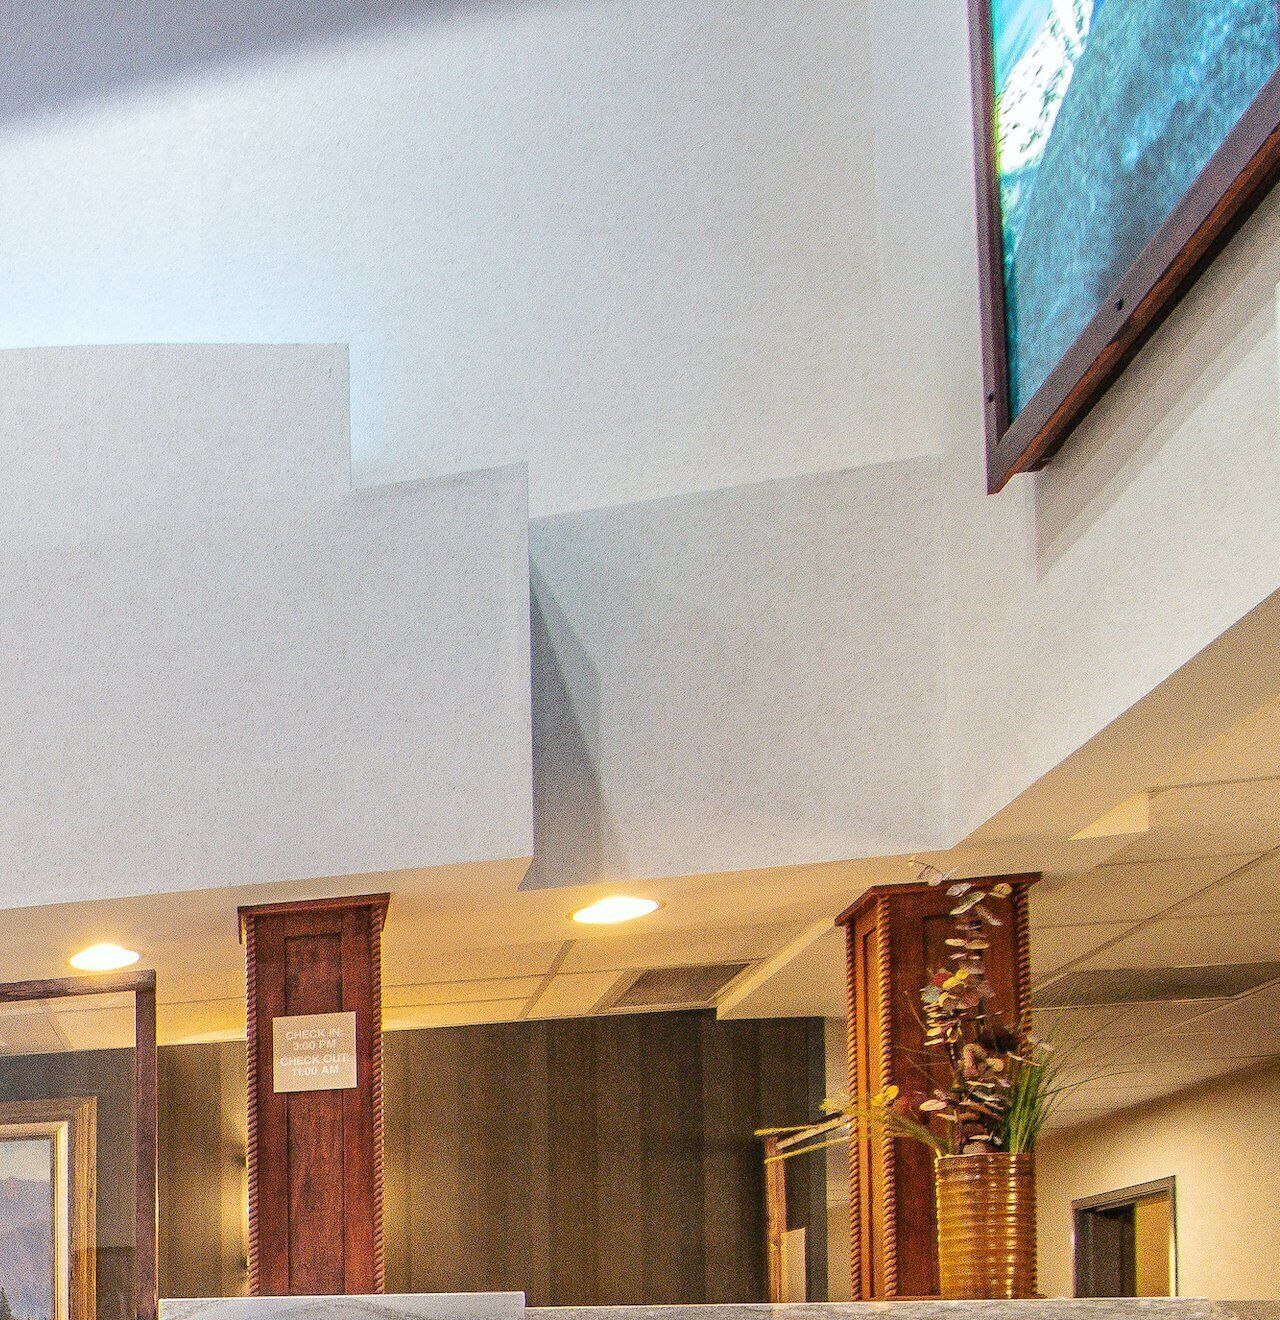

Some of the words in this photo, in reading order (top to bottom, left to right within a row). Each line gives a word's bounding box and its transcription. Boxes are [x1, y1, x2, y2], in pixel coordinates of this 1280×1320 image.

[286, 1028, 327, 1040] CHECK
[293, 1040, 316, 1051] 3:00
[319, 1039, 337, 1049] PM
[280, 1055, 320, 1067] CHECK
[292, 1067, 318, 1077] 11:00
[321, 1065, 339, 1075] AM
